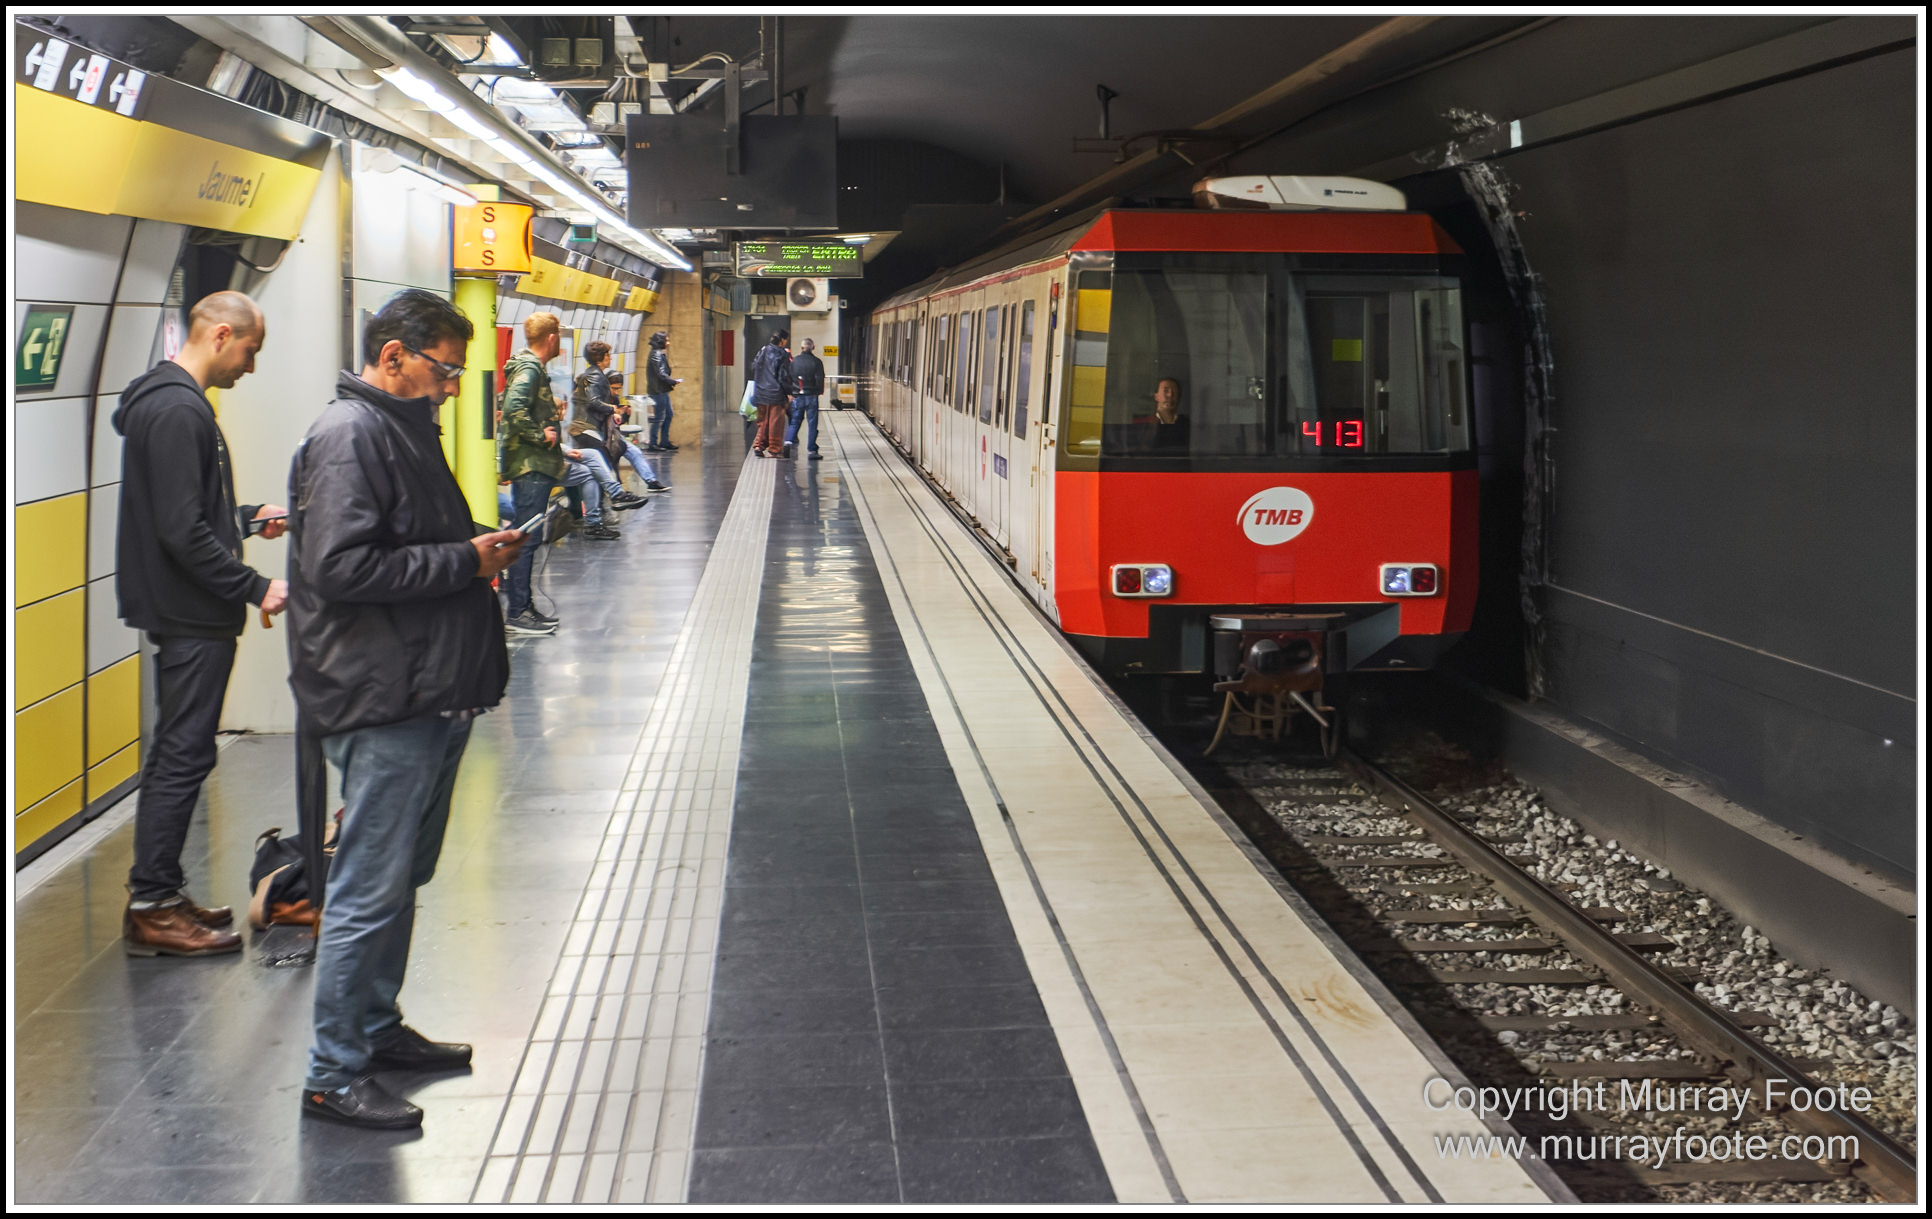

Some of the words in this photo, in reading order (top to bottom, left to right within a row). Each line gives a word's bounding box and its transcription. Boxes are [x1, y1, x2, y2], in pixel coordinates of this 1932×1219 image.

[198, 160, 252, 206] Jaume
[482, 206, 496, 223] S
[481, 249, 495, 266] S
[1254, 509, 1304, 526] TMB
